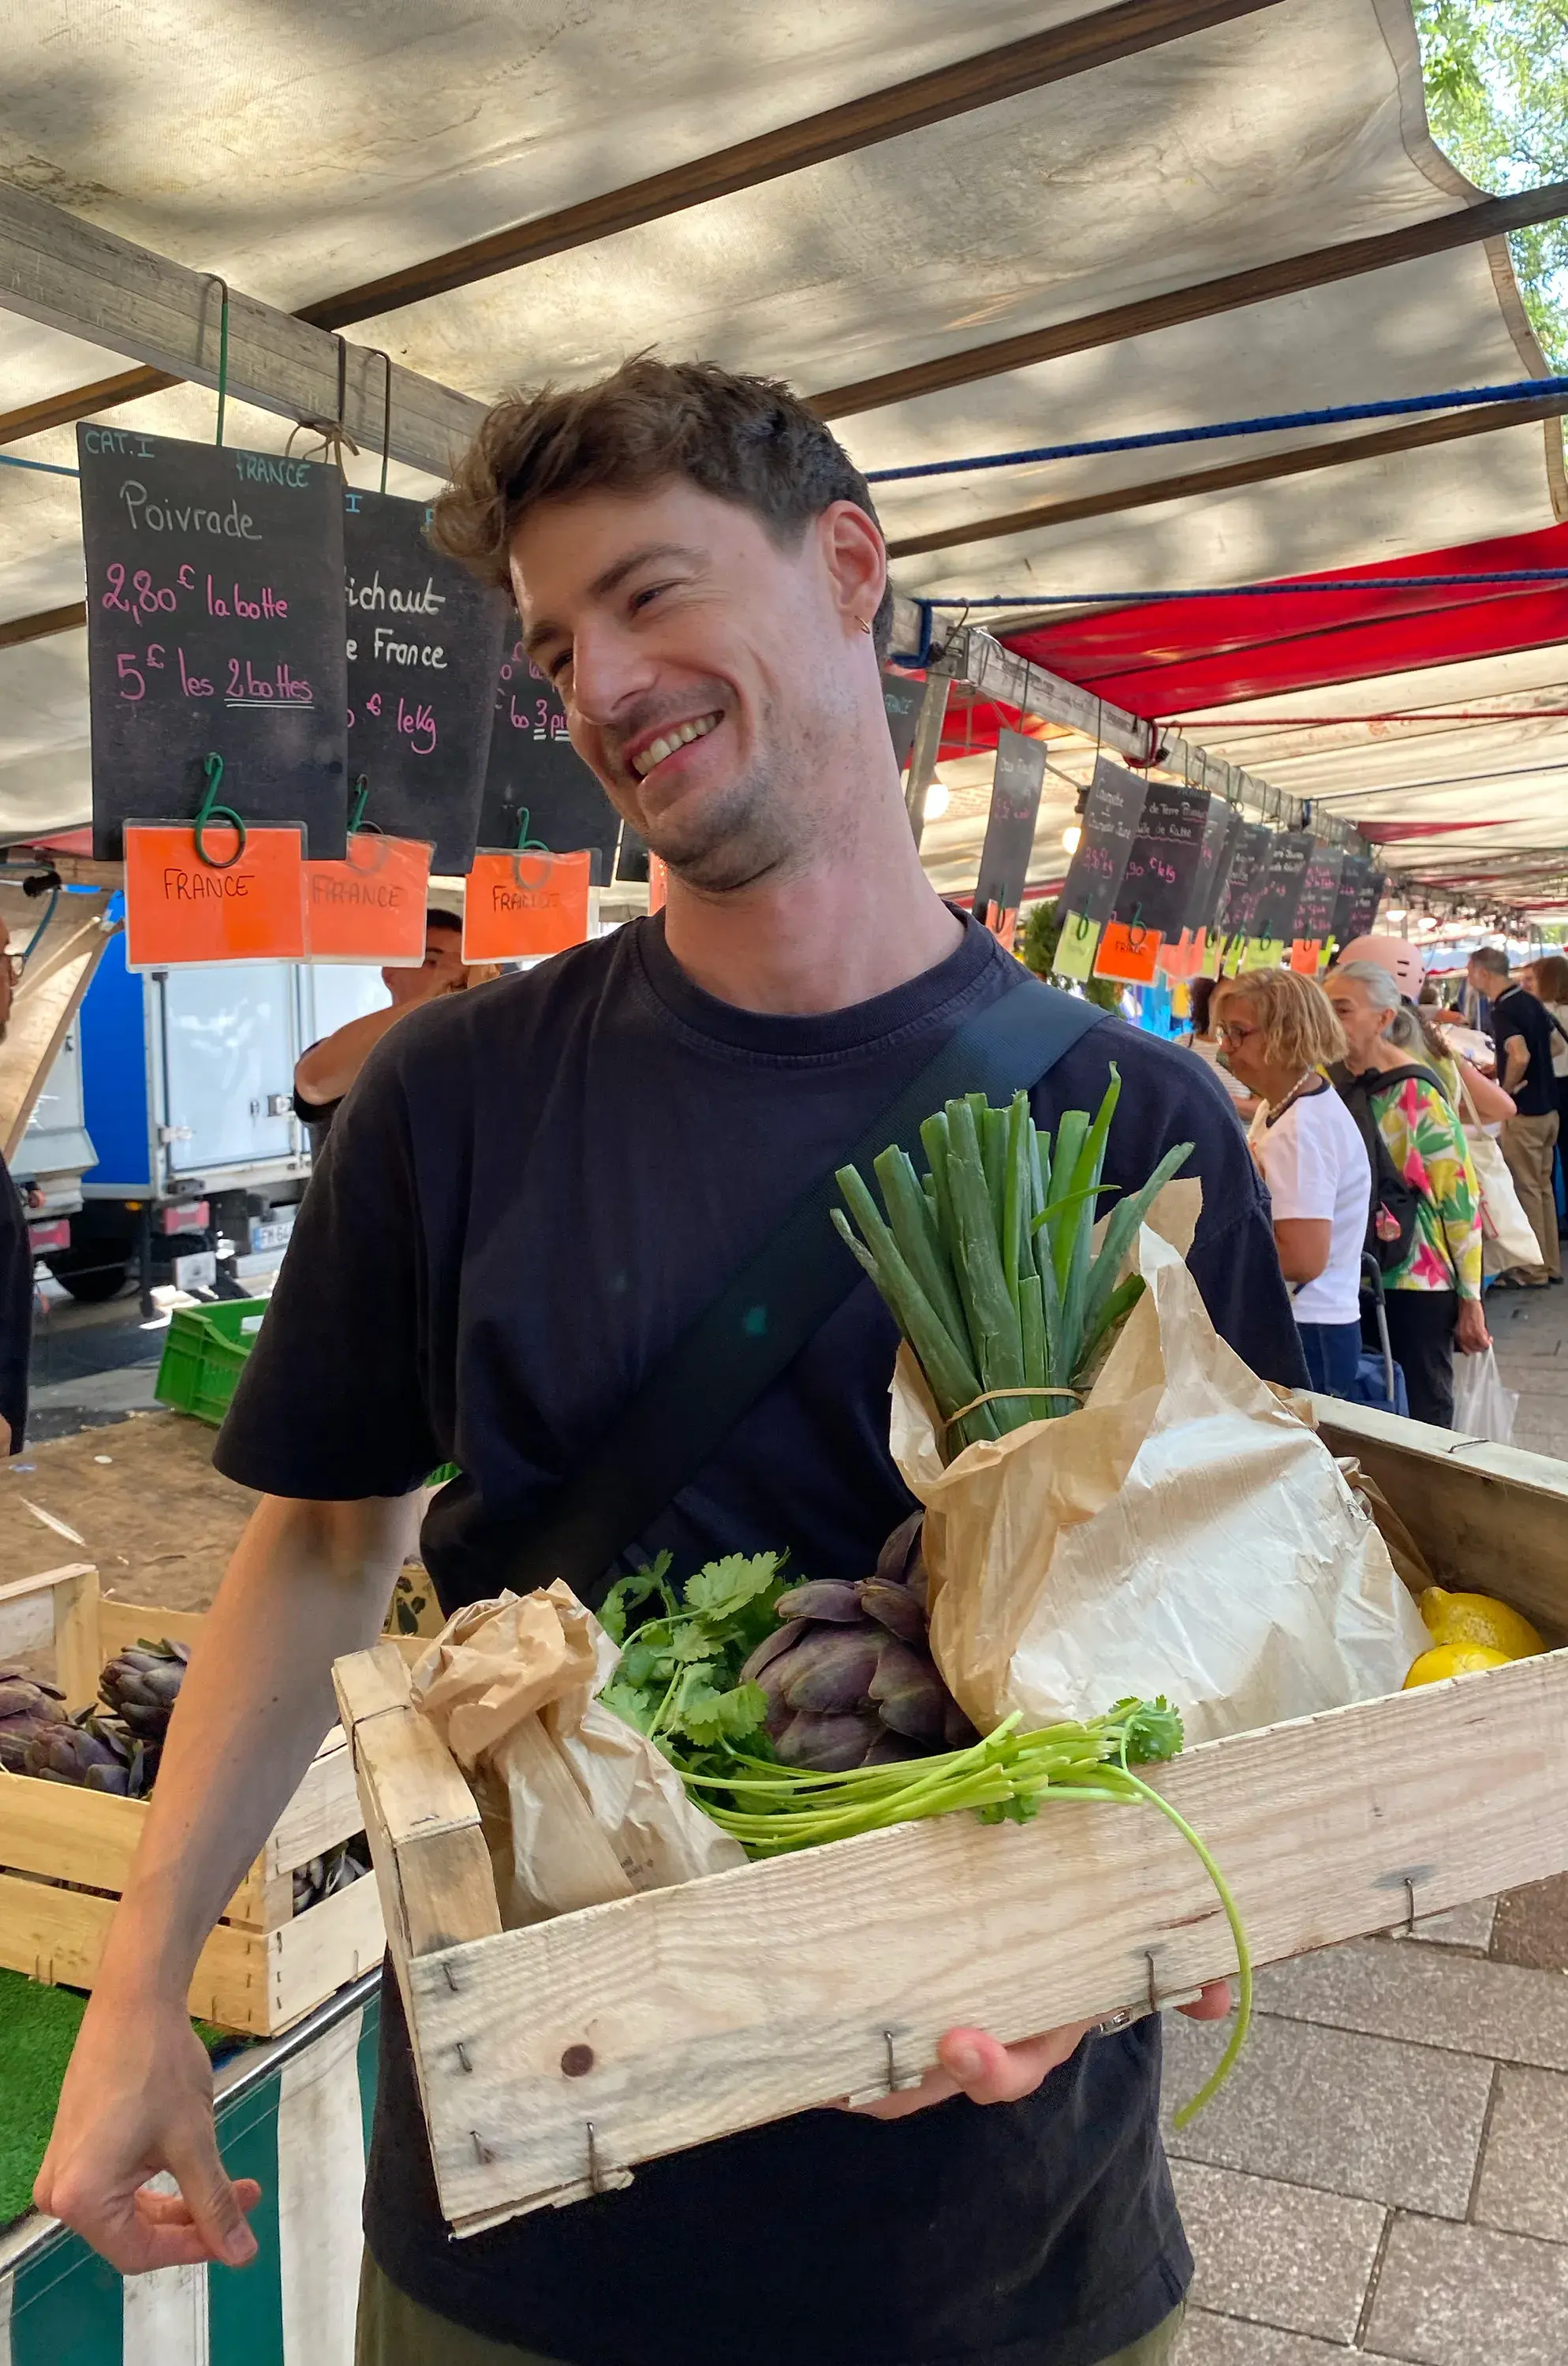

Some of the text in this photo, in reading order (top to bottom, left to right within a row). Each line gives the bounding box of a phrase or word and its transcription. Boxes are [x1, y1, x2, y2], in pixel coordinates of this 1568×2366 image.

[236, 450, 312, 487] FRANCE
[119, 480, 263, 540] Poivrade
[345, 569, 447, 615] ichaut
[346, 628, 448, 670] e France
[177, 647, 215, 697] les
[164, 868, 256, 900] FRANCE
